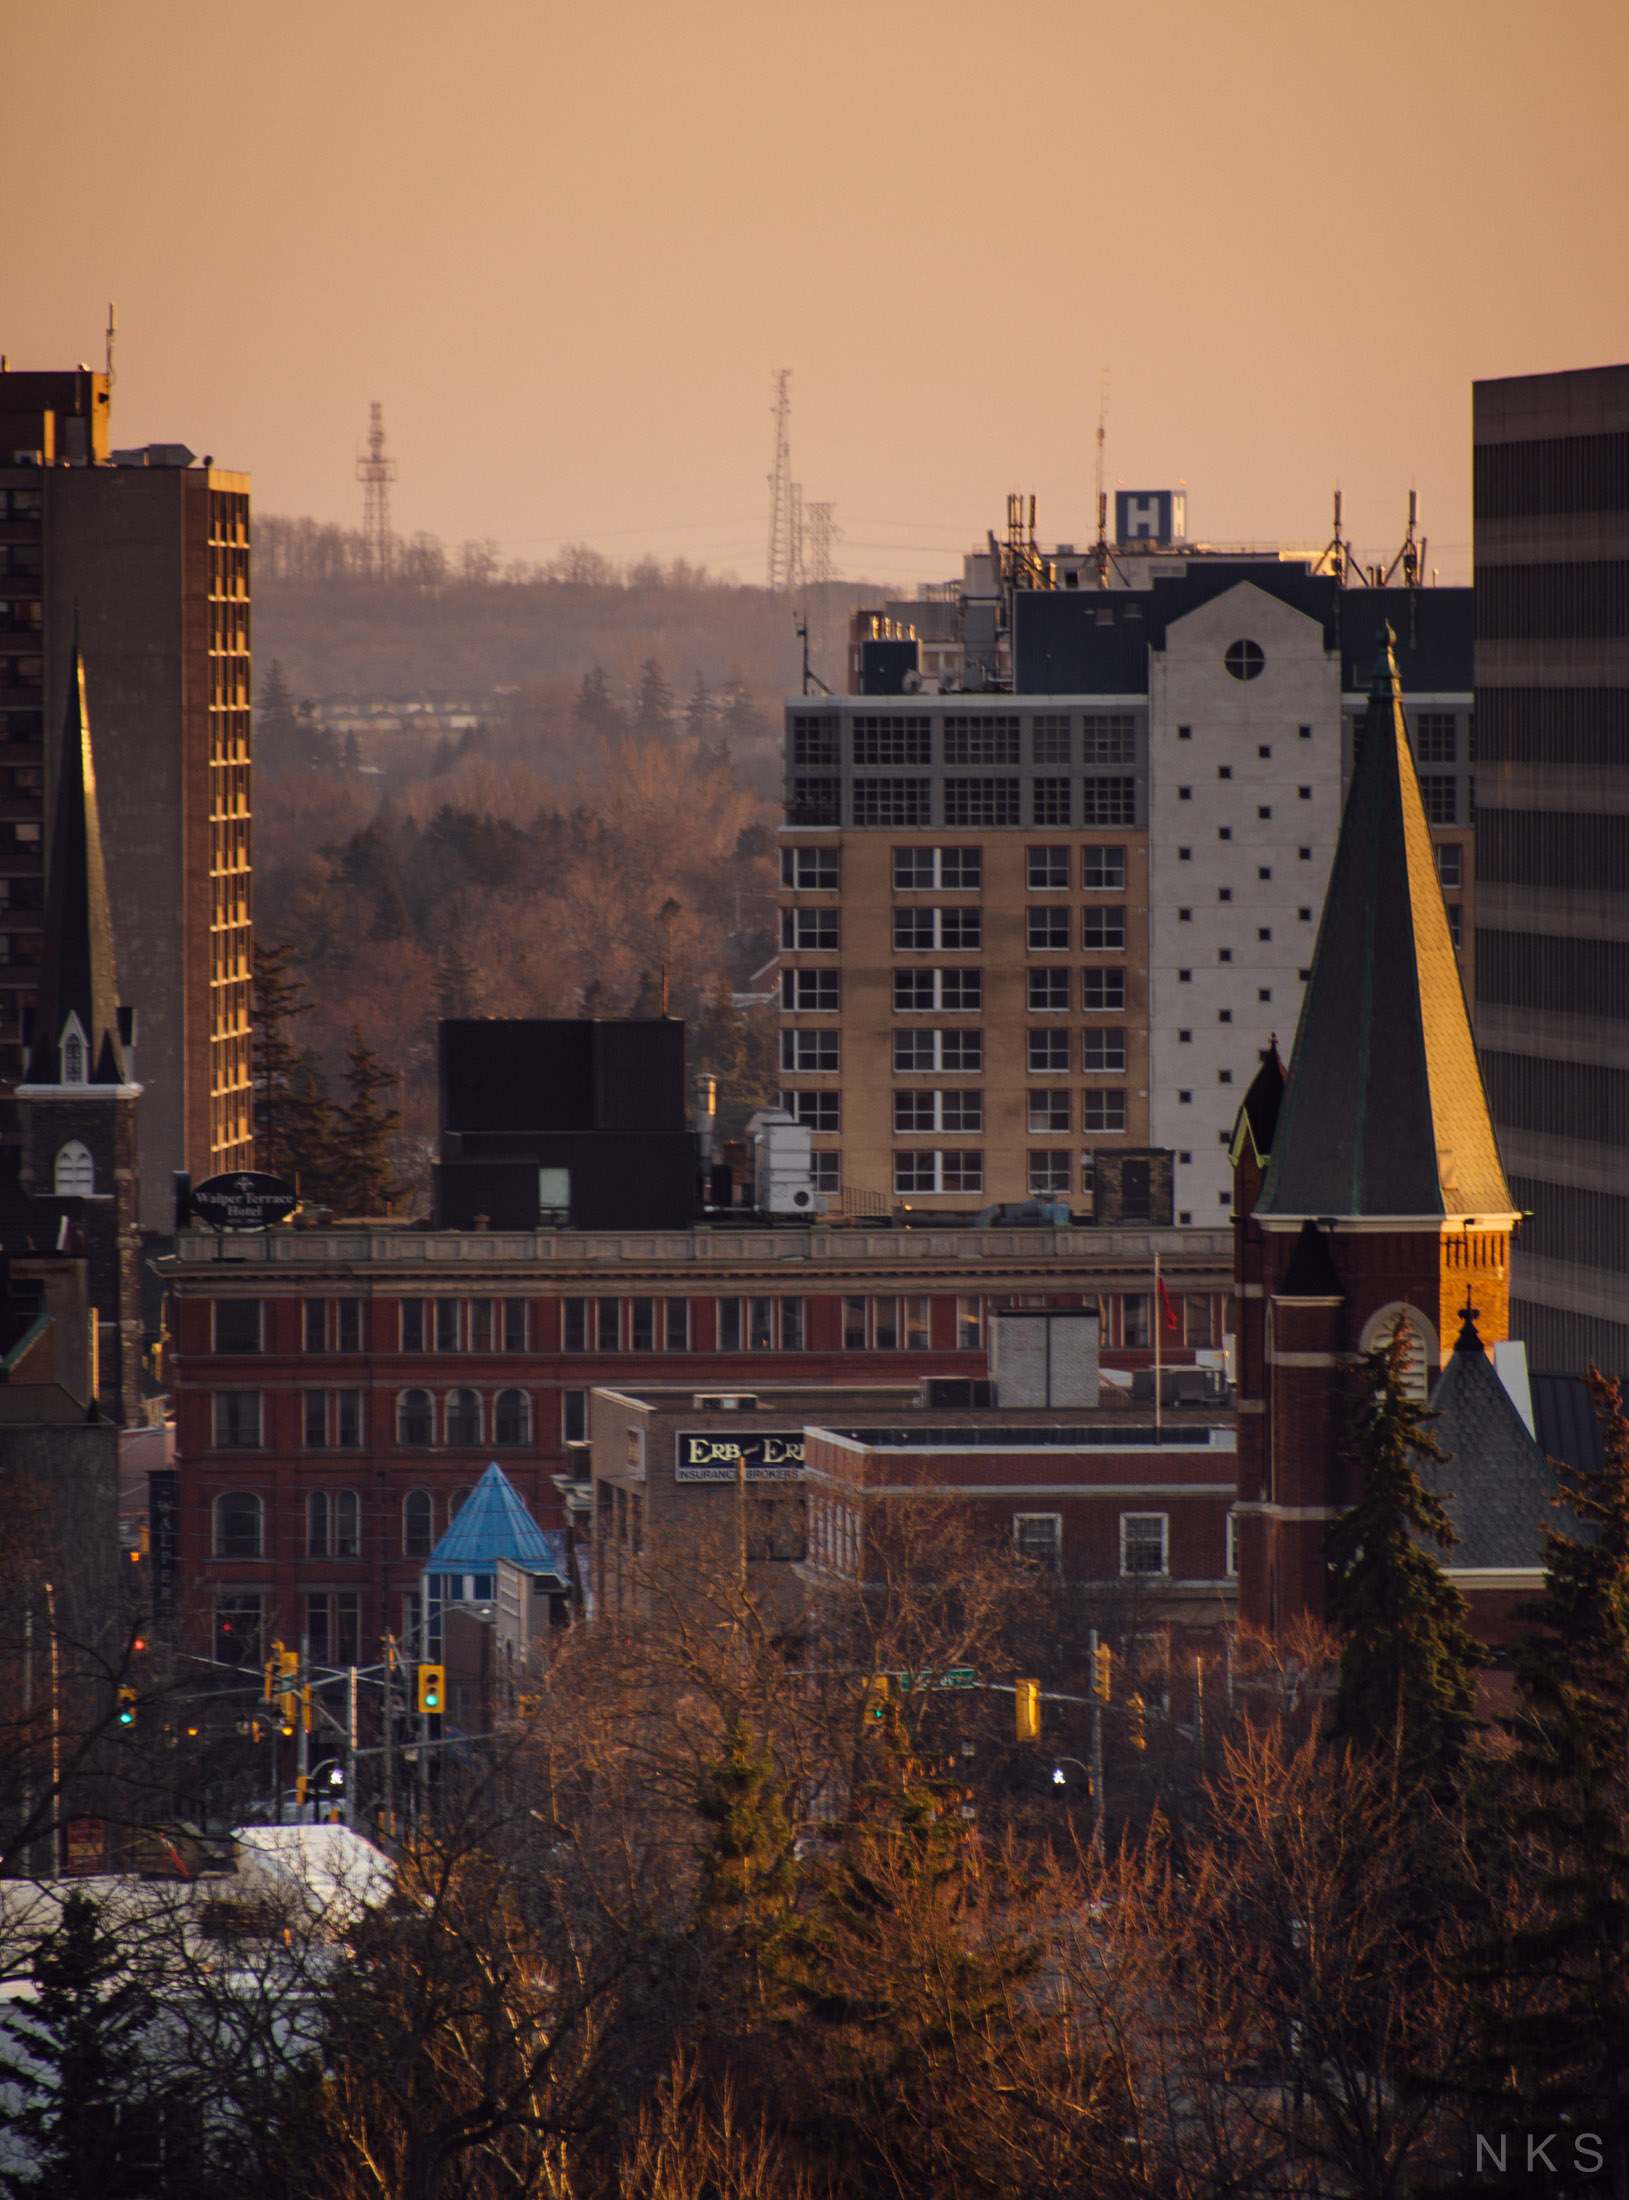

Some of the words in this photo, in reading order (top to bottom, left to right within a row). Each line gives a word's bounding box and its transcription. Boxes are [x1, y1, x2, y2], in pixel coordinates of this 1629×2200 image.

[1127, 497, 1159, 537] H
[196, 1192, 242, 1206] Walper
[245, 1192, 293, 1204] Terrace
[228, 1206, 261, 1216] Hotel
[688, 1439, 742, 1463] ERB
[678, 1470, 735, 1479] INSURANC
[746, 1470, 799, 1479] BROKERS
